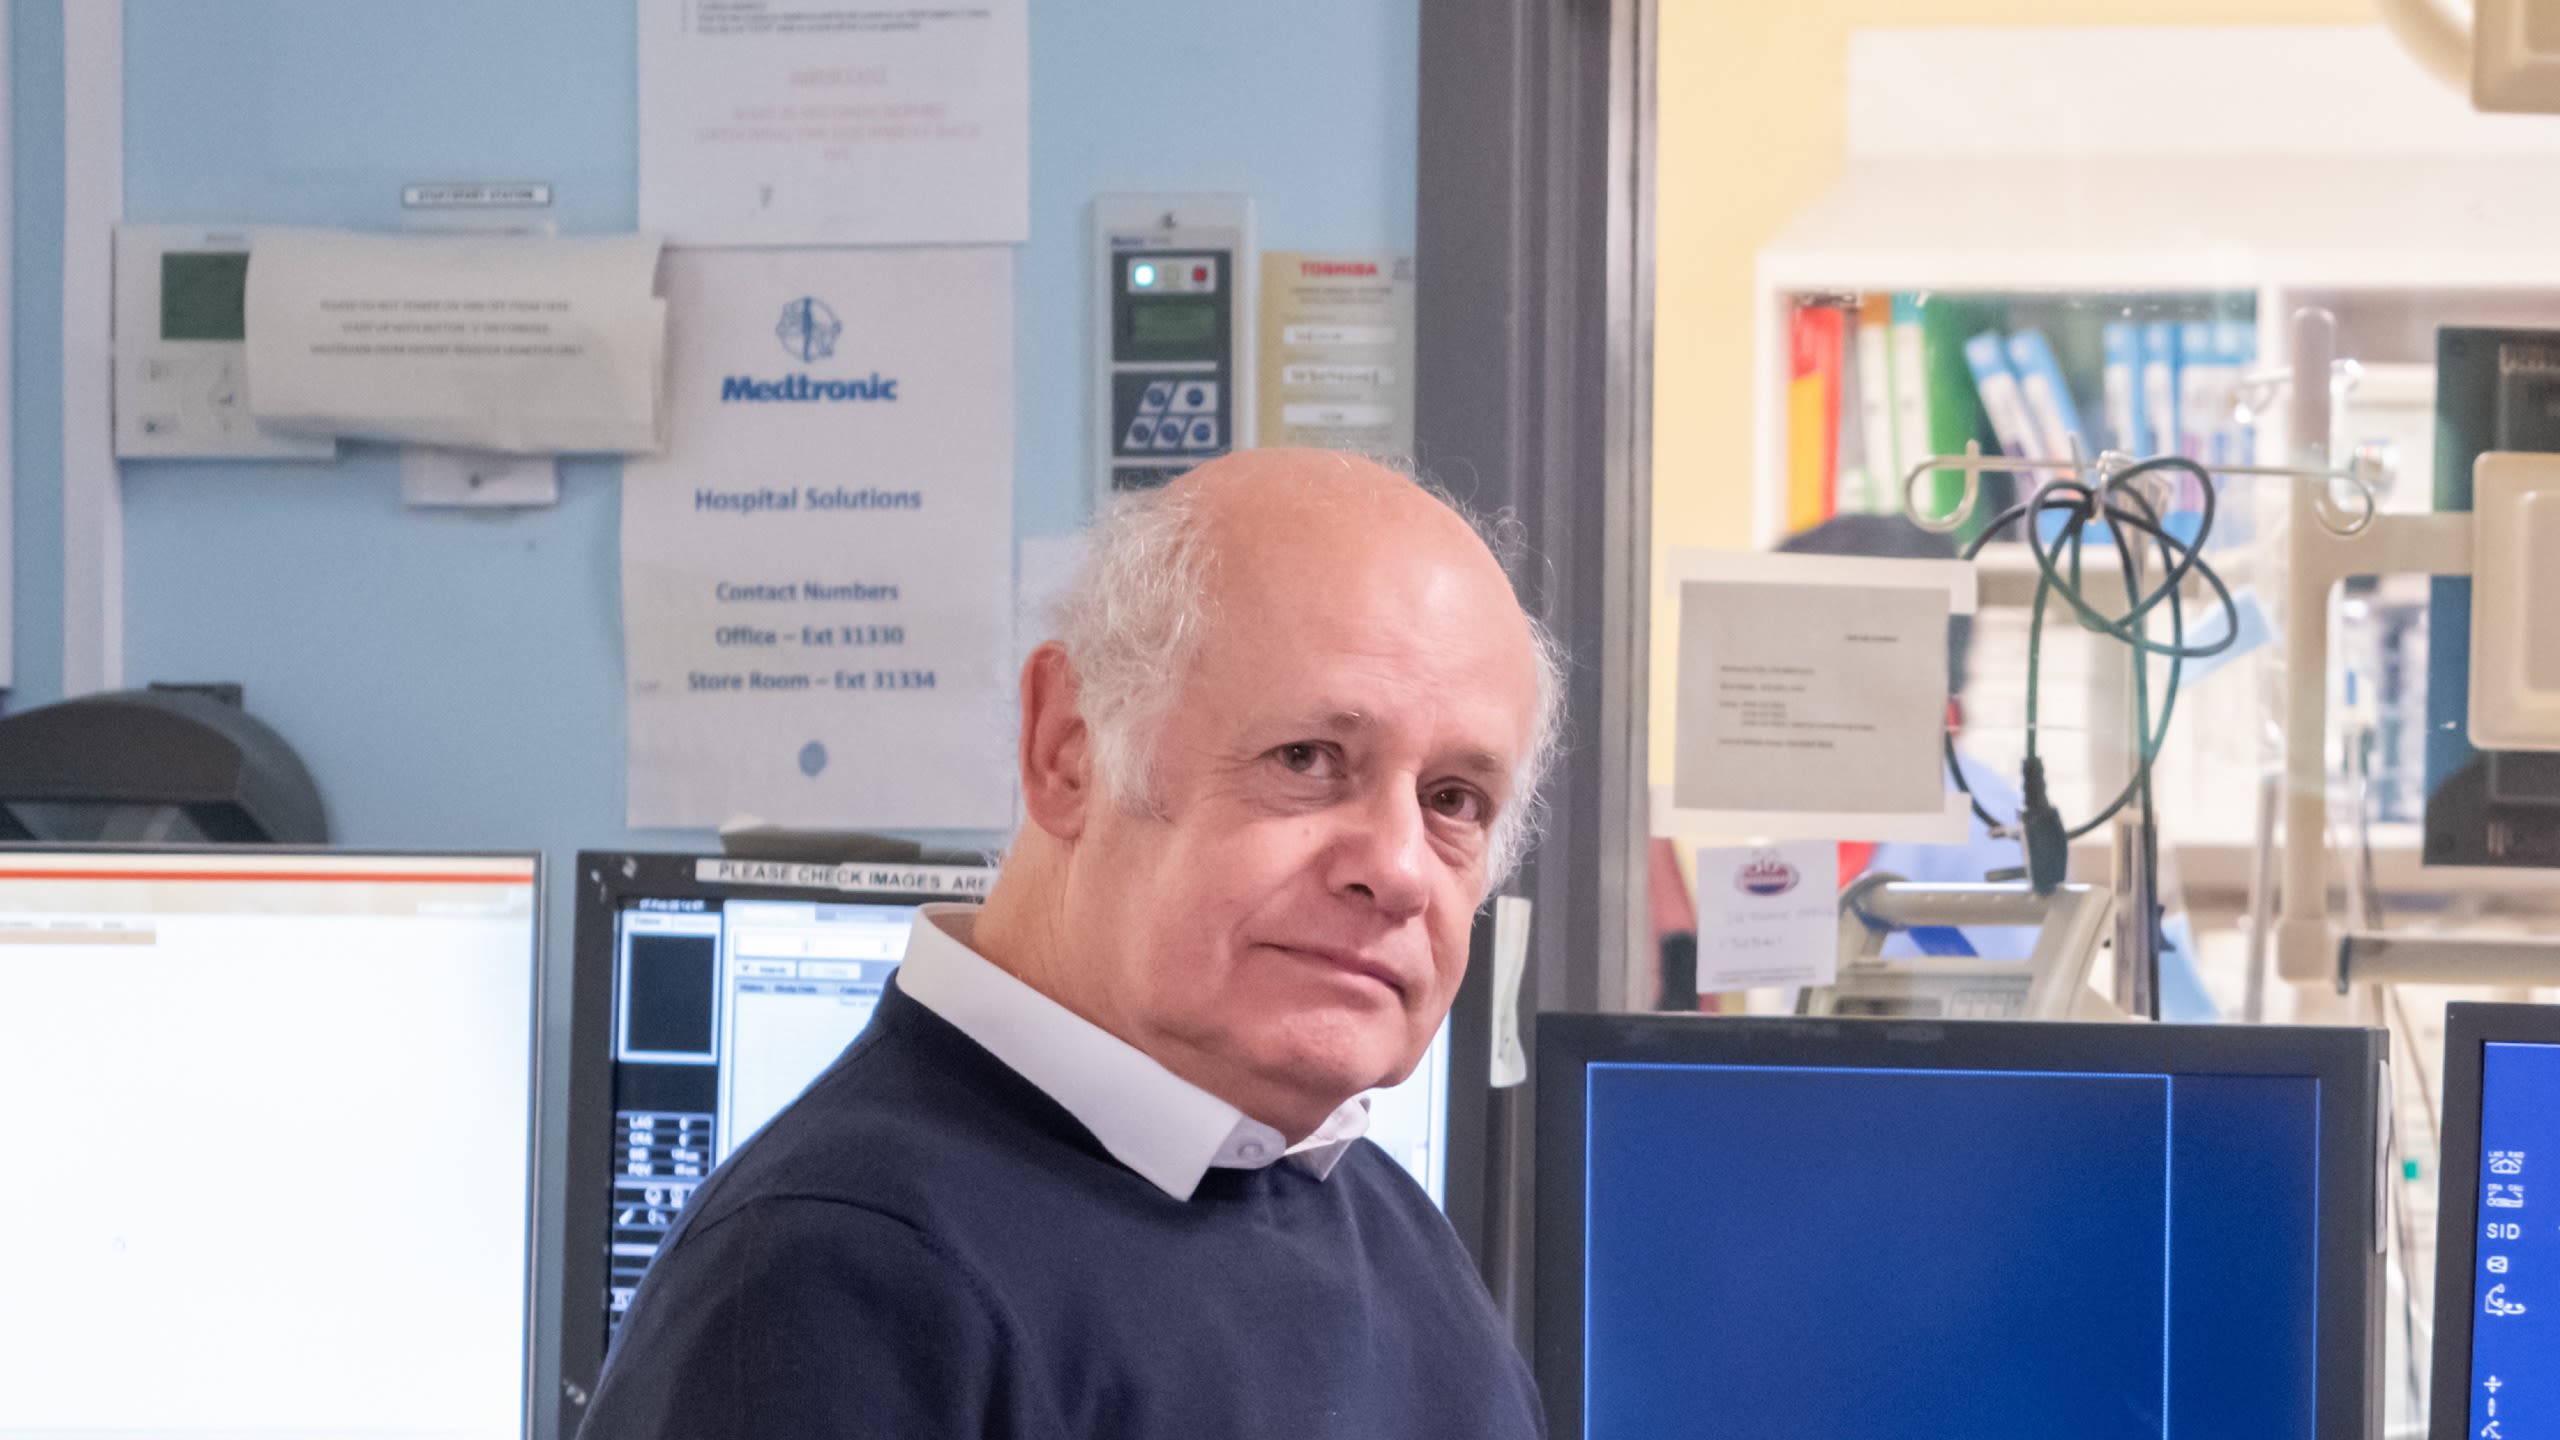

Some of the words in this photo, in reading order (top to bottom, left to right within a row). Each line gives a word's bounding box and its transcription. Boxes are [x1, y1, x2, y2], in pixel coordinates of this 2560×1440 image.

[1300, 262, 1378, 277] TOSHIBA
[721, 372, 898, 402] Medtronic
[695, 487, 797, 514] Hospital
[805, 487, 922, 510] Solutions
[716, 581, 797, 602] Contact
[803, 581, 900, 602] Numbers
[715, 626, 777, 646] Office
[801, 626, 834, 646] Ext
[840, 626, 904, 646] 31330
[688, 671, 742, 691] Store
[748, 671, 810, 691] Room
[834, 671, 866, 691] Ext
[872, 671, 936, 691] 31334
[718, 863, 790, 881] PLEASE
[797, 866, 862, 885] CHECK
[868, 872, 941, 889] IMAGES
[951, 876, 988, 892] ARE
[2486, 1222, 2520, 1240] SID
